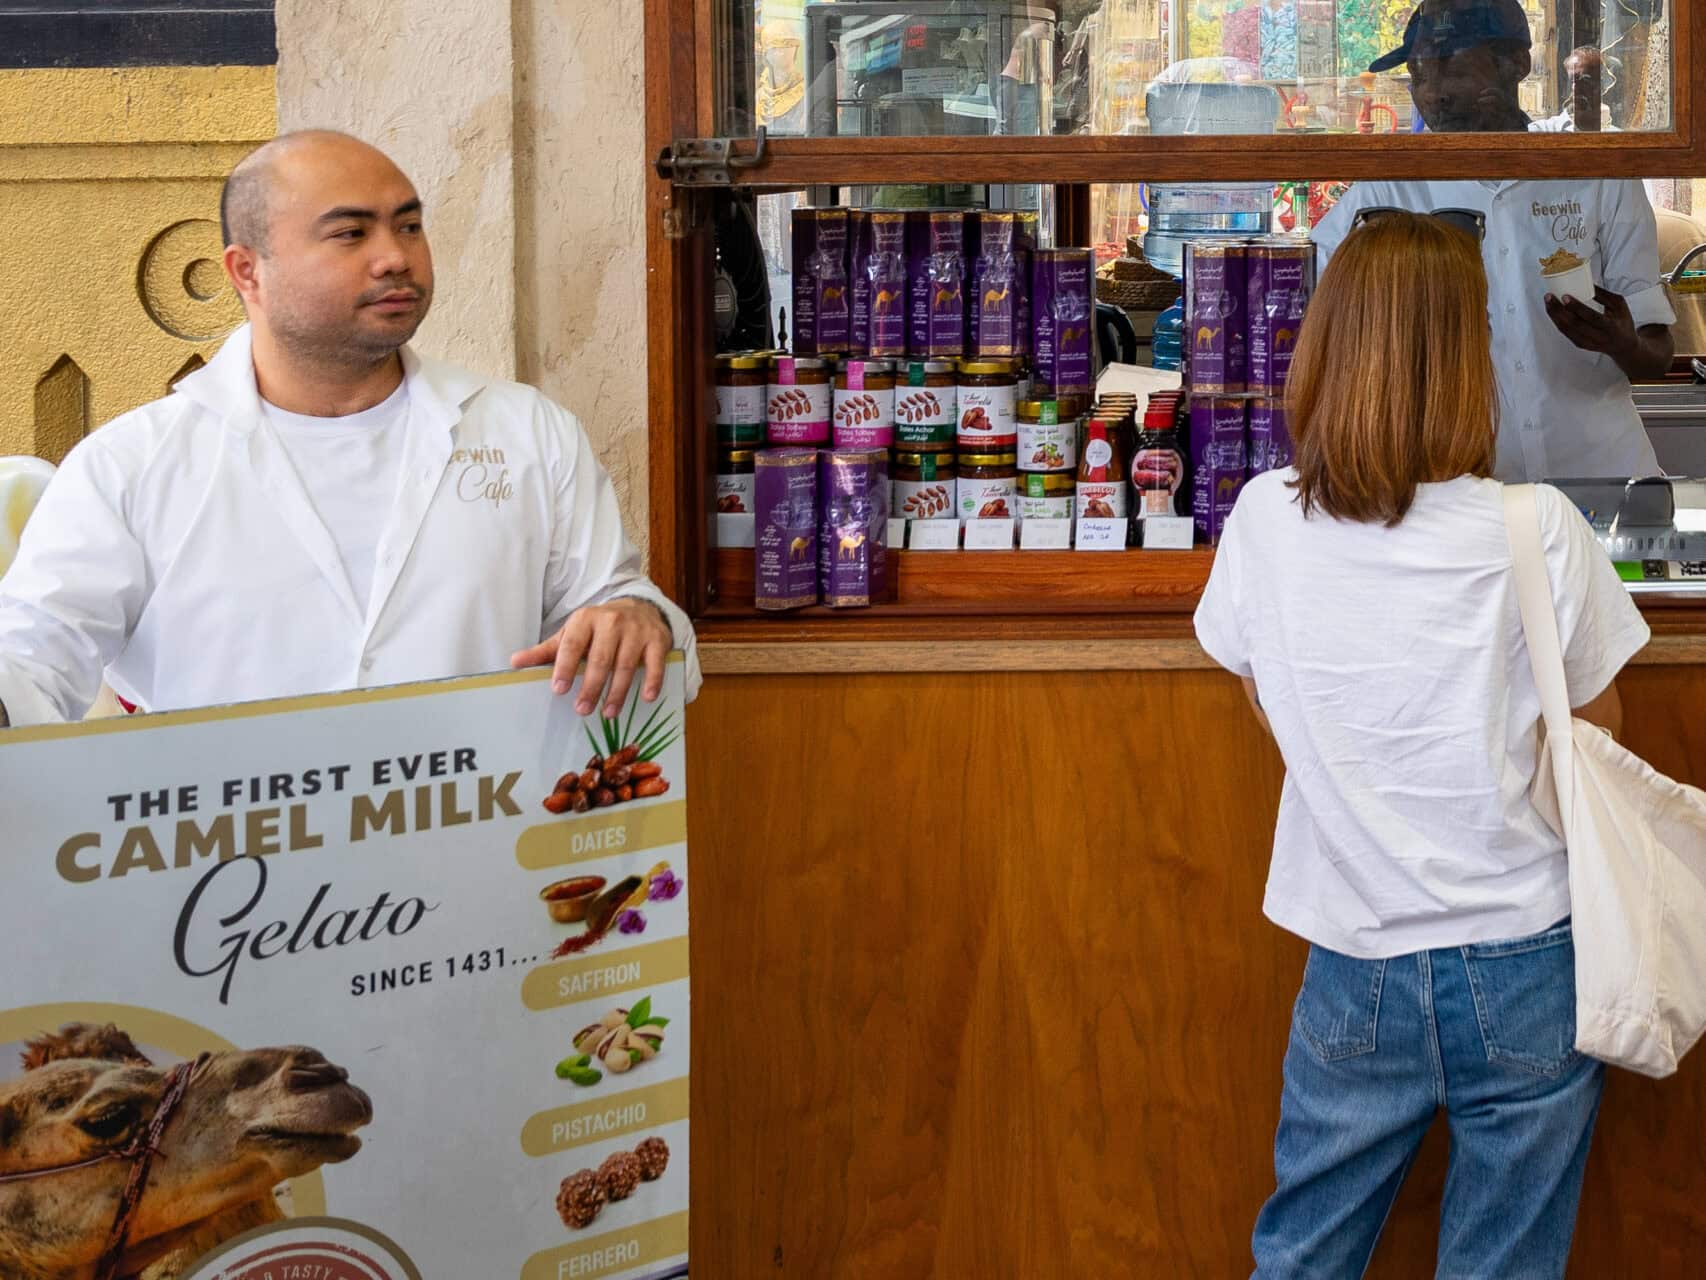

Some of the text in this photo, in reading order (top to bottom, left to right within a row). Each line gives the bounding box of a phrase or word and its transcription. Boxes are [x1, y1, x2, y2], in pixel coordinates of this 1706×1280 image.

[1532, 199, 1582, 216] Geewin
[106, 746, 479, 824] THE FIRST EVER
[54, 771, 524, 885] CAMEL MILK
[571, 825, 628, 856] DATES
[173, 854, 440, 1005] Gelato
[350, 962, 433, 997] SINCE
[557, 961, 642, 998] SAFFRON
[550, 1102, 648, 1145] PISTACHIO
[280, 1263, 334, 1280] TASTY
[557, 1240, 641, 1279] FERRERO
